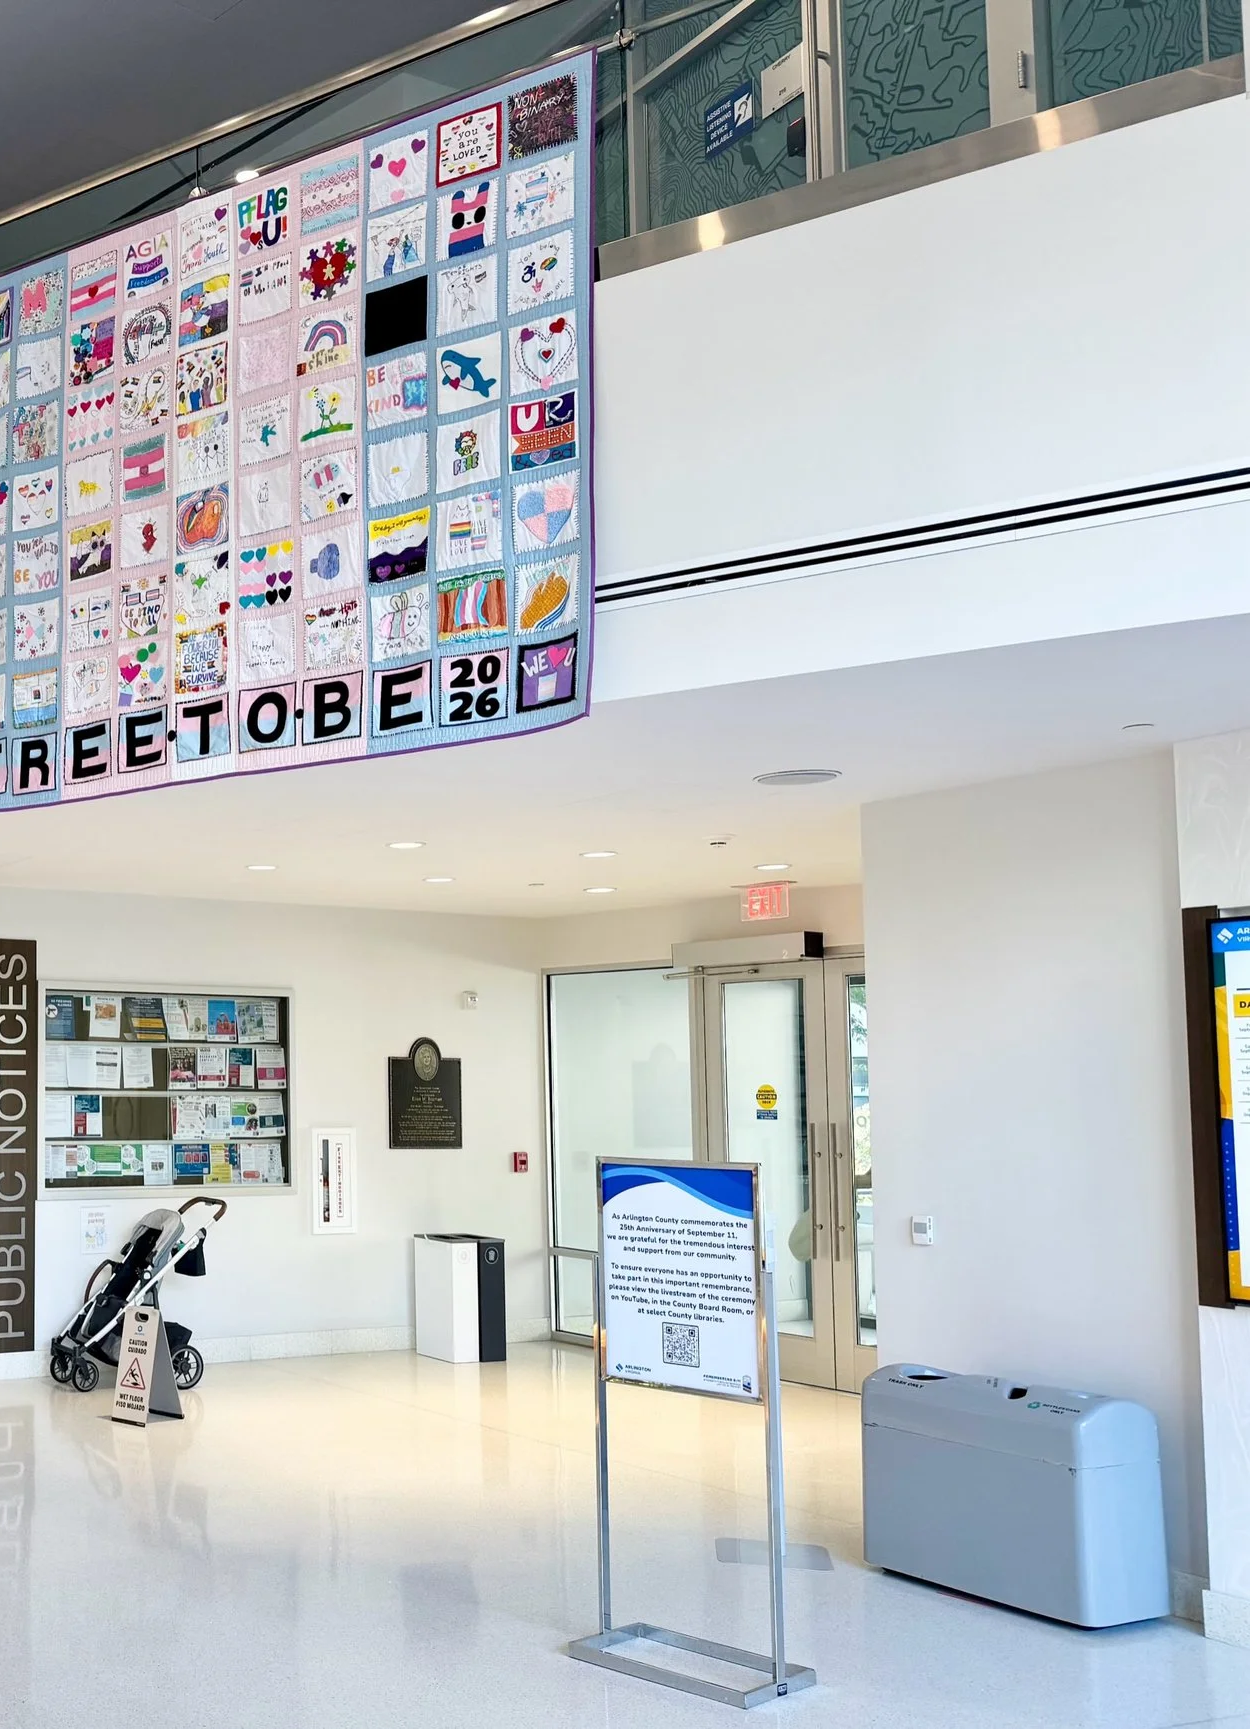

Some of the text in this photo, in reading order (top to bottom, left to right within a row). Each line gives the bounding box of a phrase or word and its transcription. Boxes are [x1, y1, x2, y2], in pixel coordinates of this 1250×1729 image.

[516, 93, 564, 121] BINARY
[706, 100, 731, 122] ASSISTIVE
[706, 110, 732, 133] LISTENING
[457, 128, 478, 141] you
[710, 123, 728, 140] DEVICE
[458, 138, 479, 149] are
[706, 129, 733, 153] AVAILABLE
[453, 146, 481, 161] LOVED
[238, 187, 287, 228] PFLAG
[125, 233, 168, 262] AGIA
[367, 366, 386, 387] BE
[367, 394, 401, 413] KIND
[521, 423, 572, 452] SEEN
[453, 451, 479, 477] FREE
[14, 568, 59, 589] BE YOU
[182, 638, 221, 654] POWERFUL
[183, 649, 219, 665] BECAUSE
[521, 647, 576, 678] WE U
[191, 663, 206, 673] WE
[450, 655, 501, 688] 20
[186, 671, 218, 685] SURVIVE
[449, 687, 500, 722] 26
[748, 886, 783, 917] EXIT
[622, 1213, 653, 1222] Arlington
[655, 1215, 679, 1225] County
[680, 1219, 734, 1228] commemorates
[736, 1221, 748, 1229] the
[619, 1223, 635, 1231] 25th
[636, 1225, 676, 1236] Anniversary
[687, 1228, 725, 1238] September
[727, 1231, 738, 1240] 11,
[630, 1235, 657, 1243] grateful
[683, 1239, 725, 1249] tremendous
[726, 1242, 755, 1252] interest
[665, 1248, 682, 1256] from
[696, 1252, 737, 1262] community.
[644, 1267, 675, 1275] everyone
[675, 1268, 688, 1276] has
[700, 1272, 743, 1282] opportunity
[665, 1278, 700, 1288] important
[701, 1283, 752, 1294] remembrance,
[631, 1285, 647, 1293] view
[707, 1293, 719, 1301] the
[721, 1296, 756, 1306] ceremony
[621, 1294, 650, 1304] YouTube,
[672, 1300, 697, 1310] County
[698, 1303, 720, 1312] Board
[721, 1305, 745, 1315] Room,
[646, 1308, 666, 1317] select
[667, 1310, 692, 1321] County
[127, 1346, 147, 1355] CUIDADO
[129, 1338, 147, 1347] CAUTION
[625, 1364, 651, 1373] ARLINGTON
[907, 1382, 925, 1390] ONLY
[119, 1393, 143, 1403] WET FLOOR
